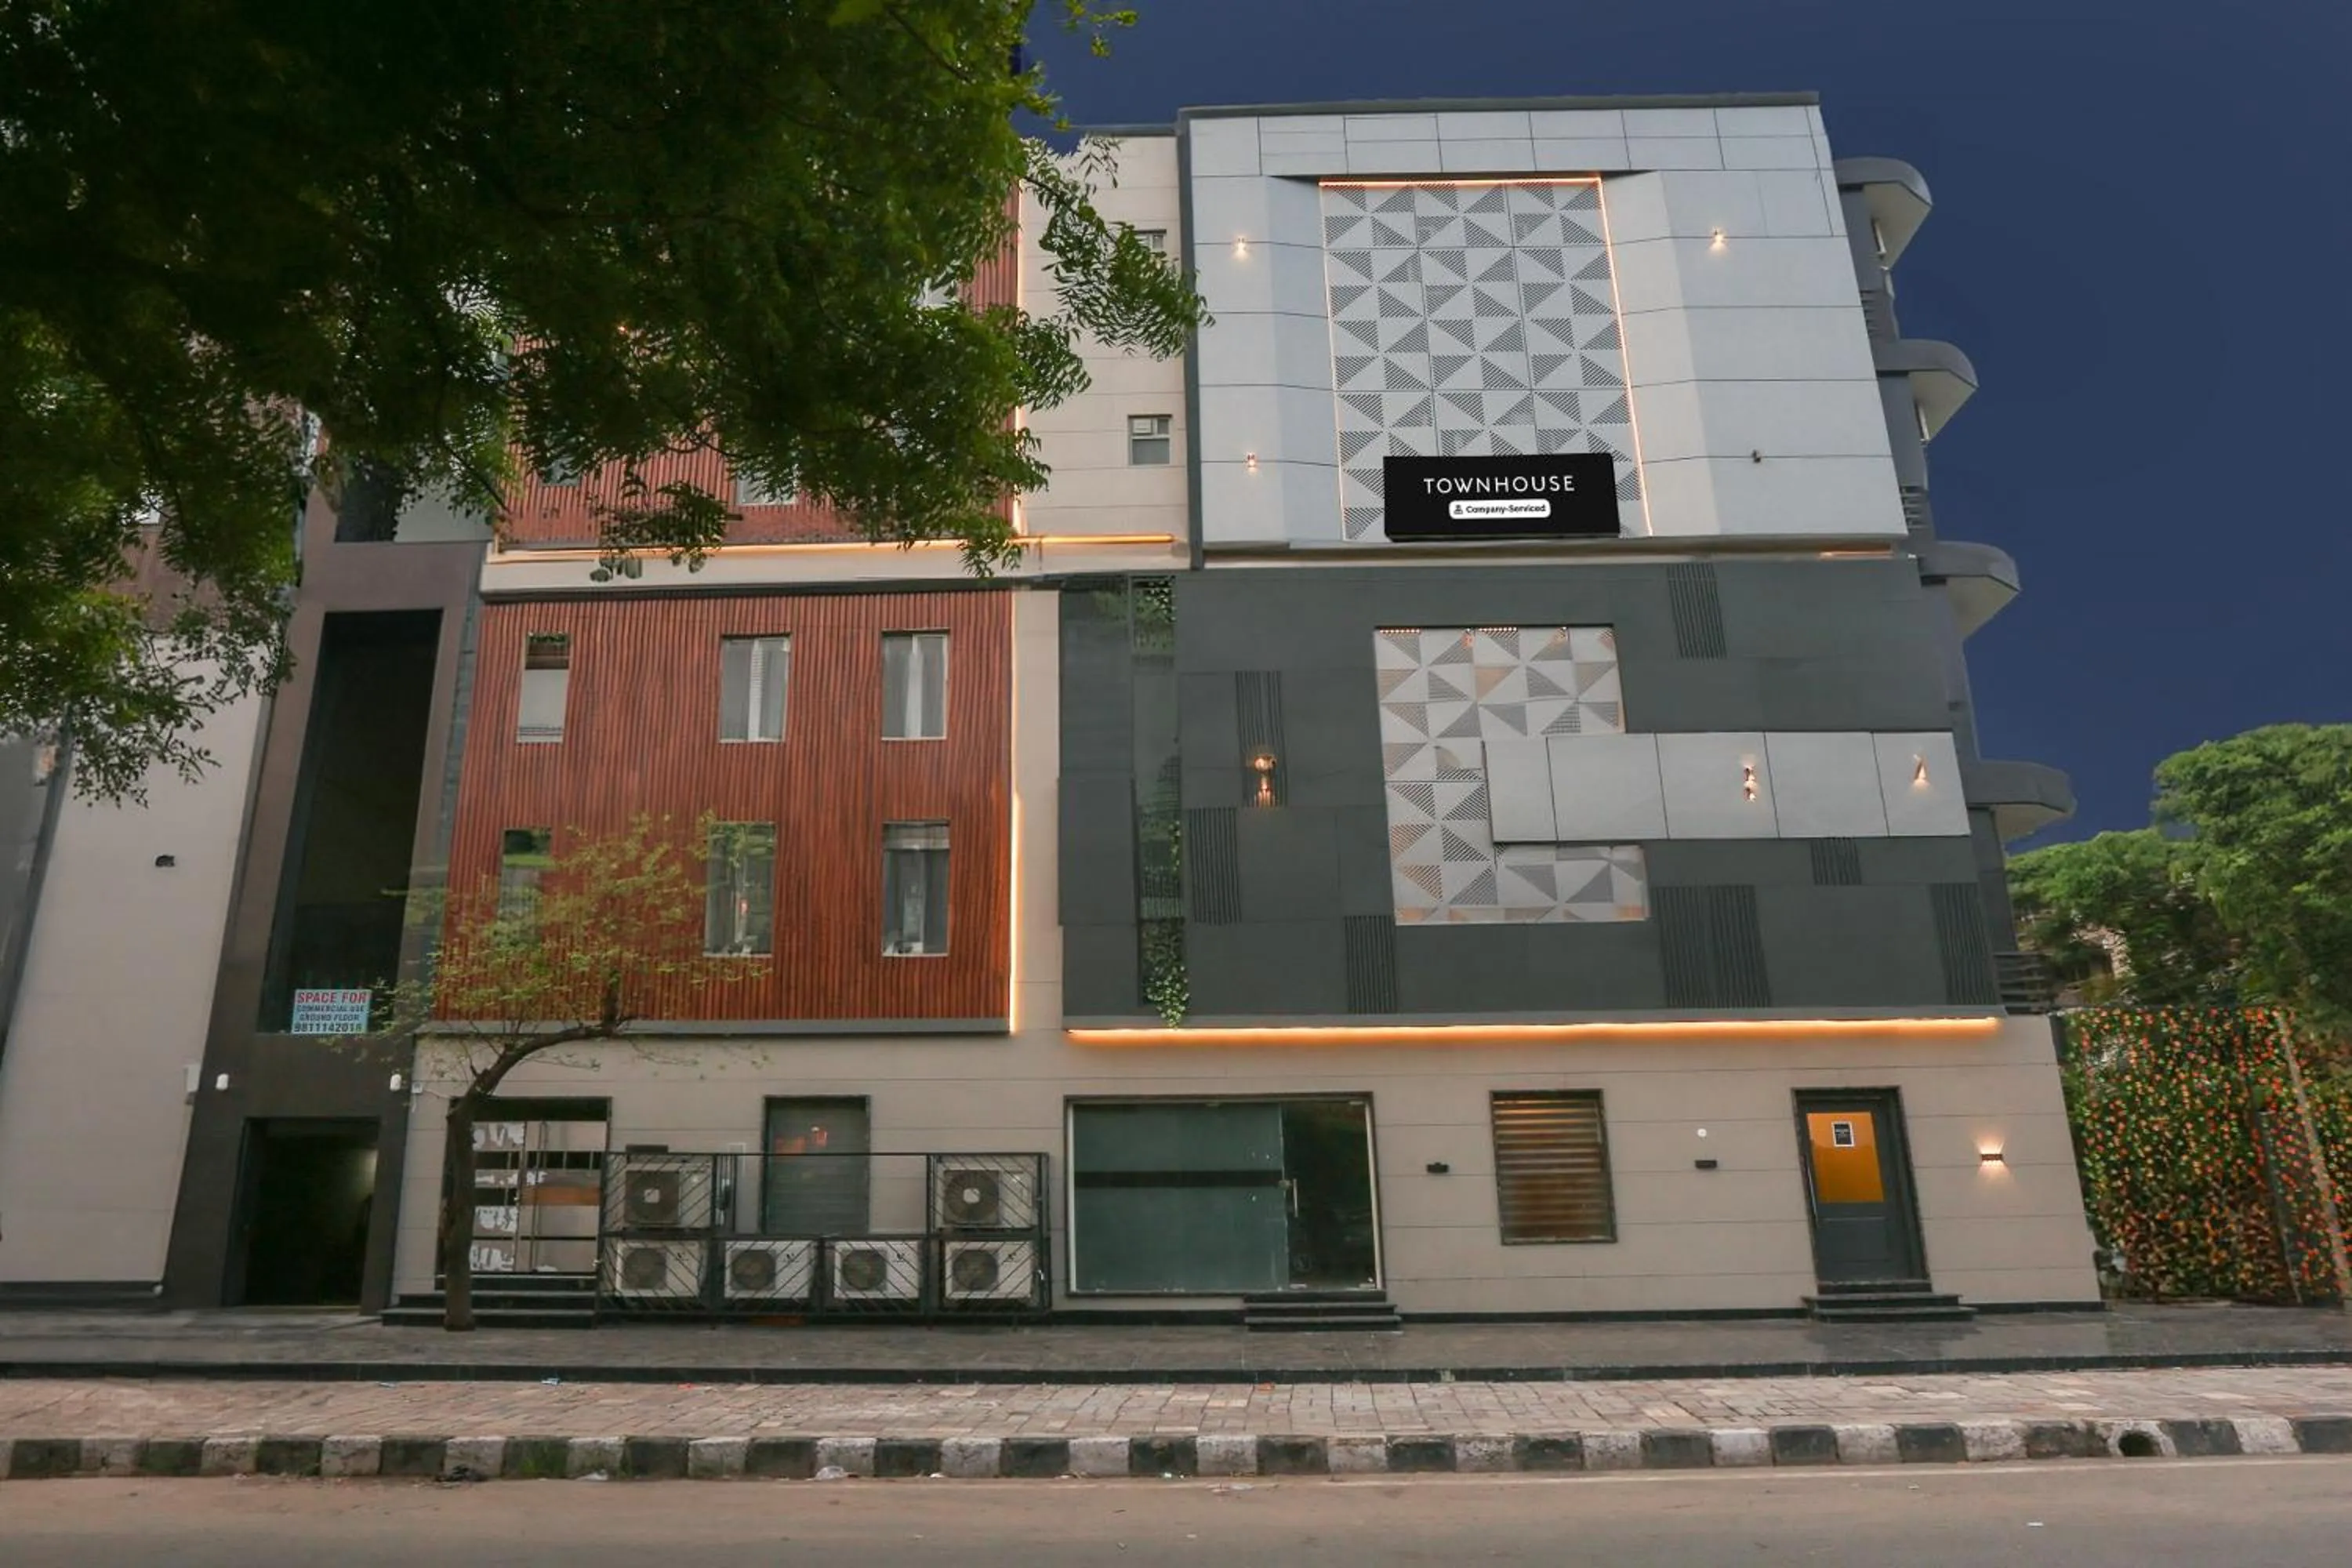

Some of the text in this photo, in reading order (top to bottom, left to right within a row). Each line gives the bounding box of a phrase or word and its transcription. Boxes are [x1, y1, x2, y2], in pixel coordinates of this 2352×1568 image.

[1423, 475, 1575, 495] TOWNHOUSE
[1465, 503, 1547, 515] Company-Serviced
[297, 992, 367, 1004] SPACE FOR
